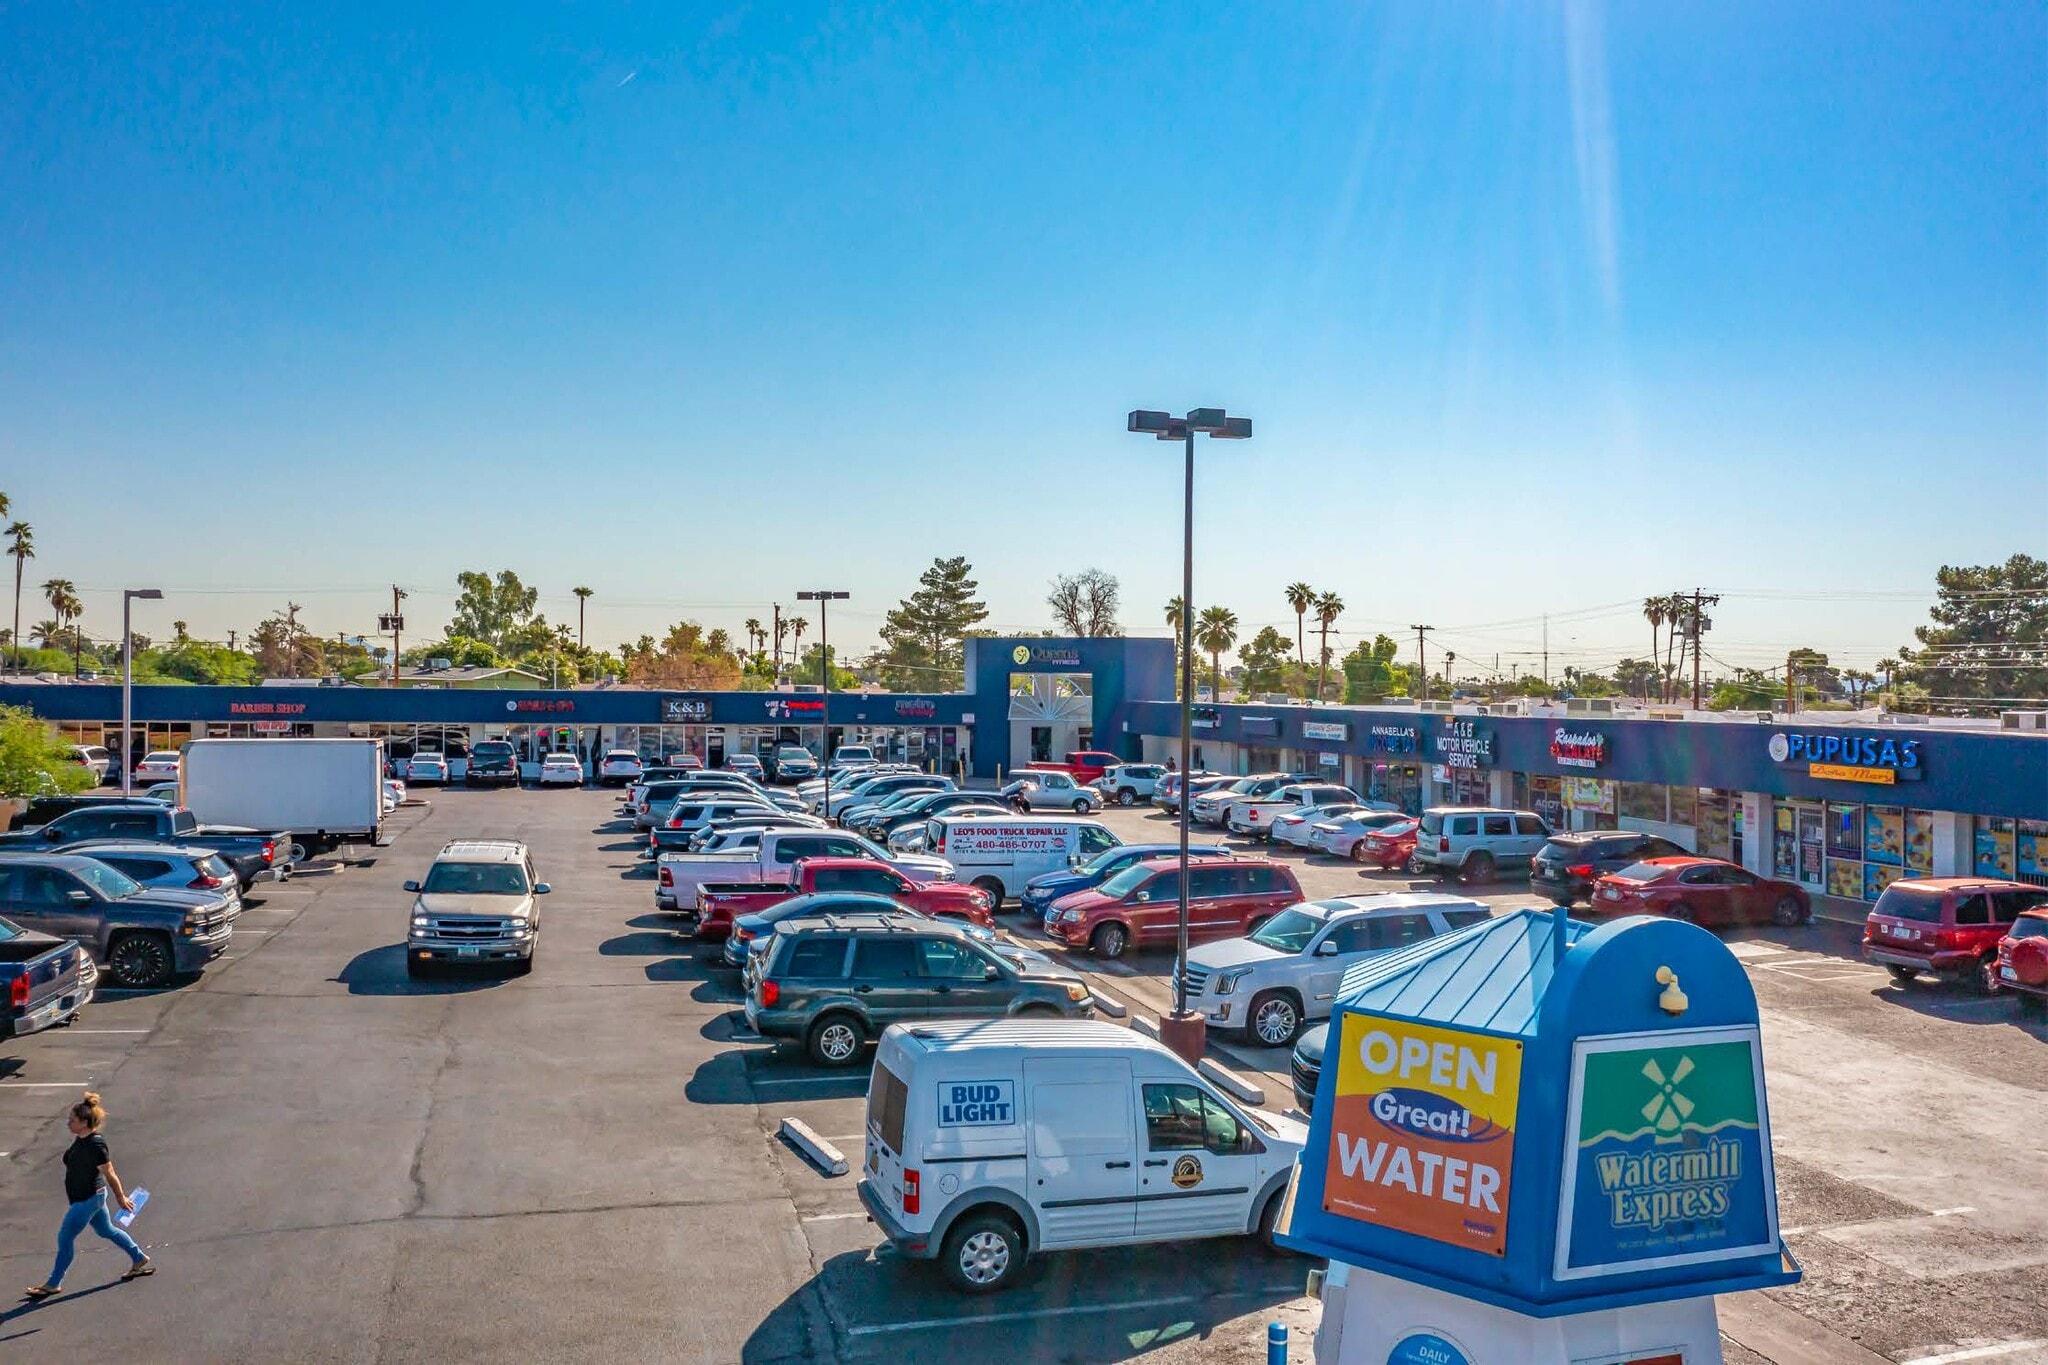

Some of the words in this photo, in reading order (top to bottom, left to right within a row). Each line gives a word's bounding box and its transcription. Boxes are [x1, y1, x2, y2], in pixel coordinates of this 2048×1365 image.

[231, 703, 274, 713] BARBER
[276, 703, 306, 713] SHOP
[669, 702, 680, 712] K
[682, 702, 693, 712] &
[696, 702, 705, 712] B
[1371, 726, 1415, 737] ANNABELLA'S
[1436, 737, 1460, 752] MOTOR
[1461, 739, 1489, 755] VEHICLE
[1789, 734, 1921, 768] PUPUSAS
[1448, 753, 1477, 769] SERVICE
[953, 828, 975, 836] LEO'S
[976, 828, 998, 836] FOOD
[999, 828, 1025, 836] TRUCK
[1026, 828, 1053, 836] REPAIR
[1054, 828, 1068, 836] LLC
[975, 840, 1047, 849] 480-486-0707
[1360, 1030, 1498, 1095] OPEN
[952, 1085, 1000, 1104] BUD
[943, 1103, 1010, 1122] LIGHT
[1373, 1091, 1471, 1138] Great!
[1337, 1132, 1501, 1214] WATER
[1597, 1138, 1741, 1192] Watermill
[1612, 1184, 1728, 1230] Express
[1420, 1345, 1450, 1364] DAILY
